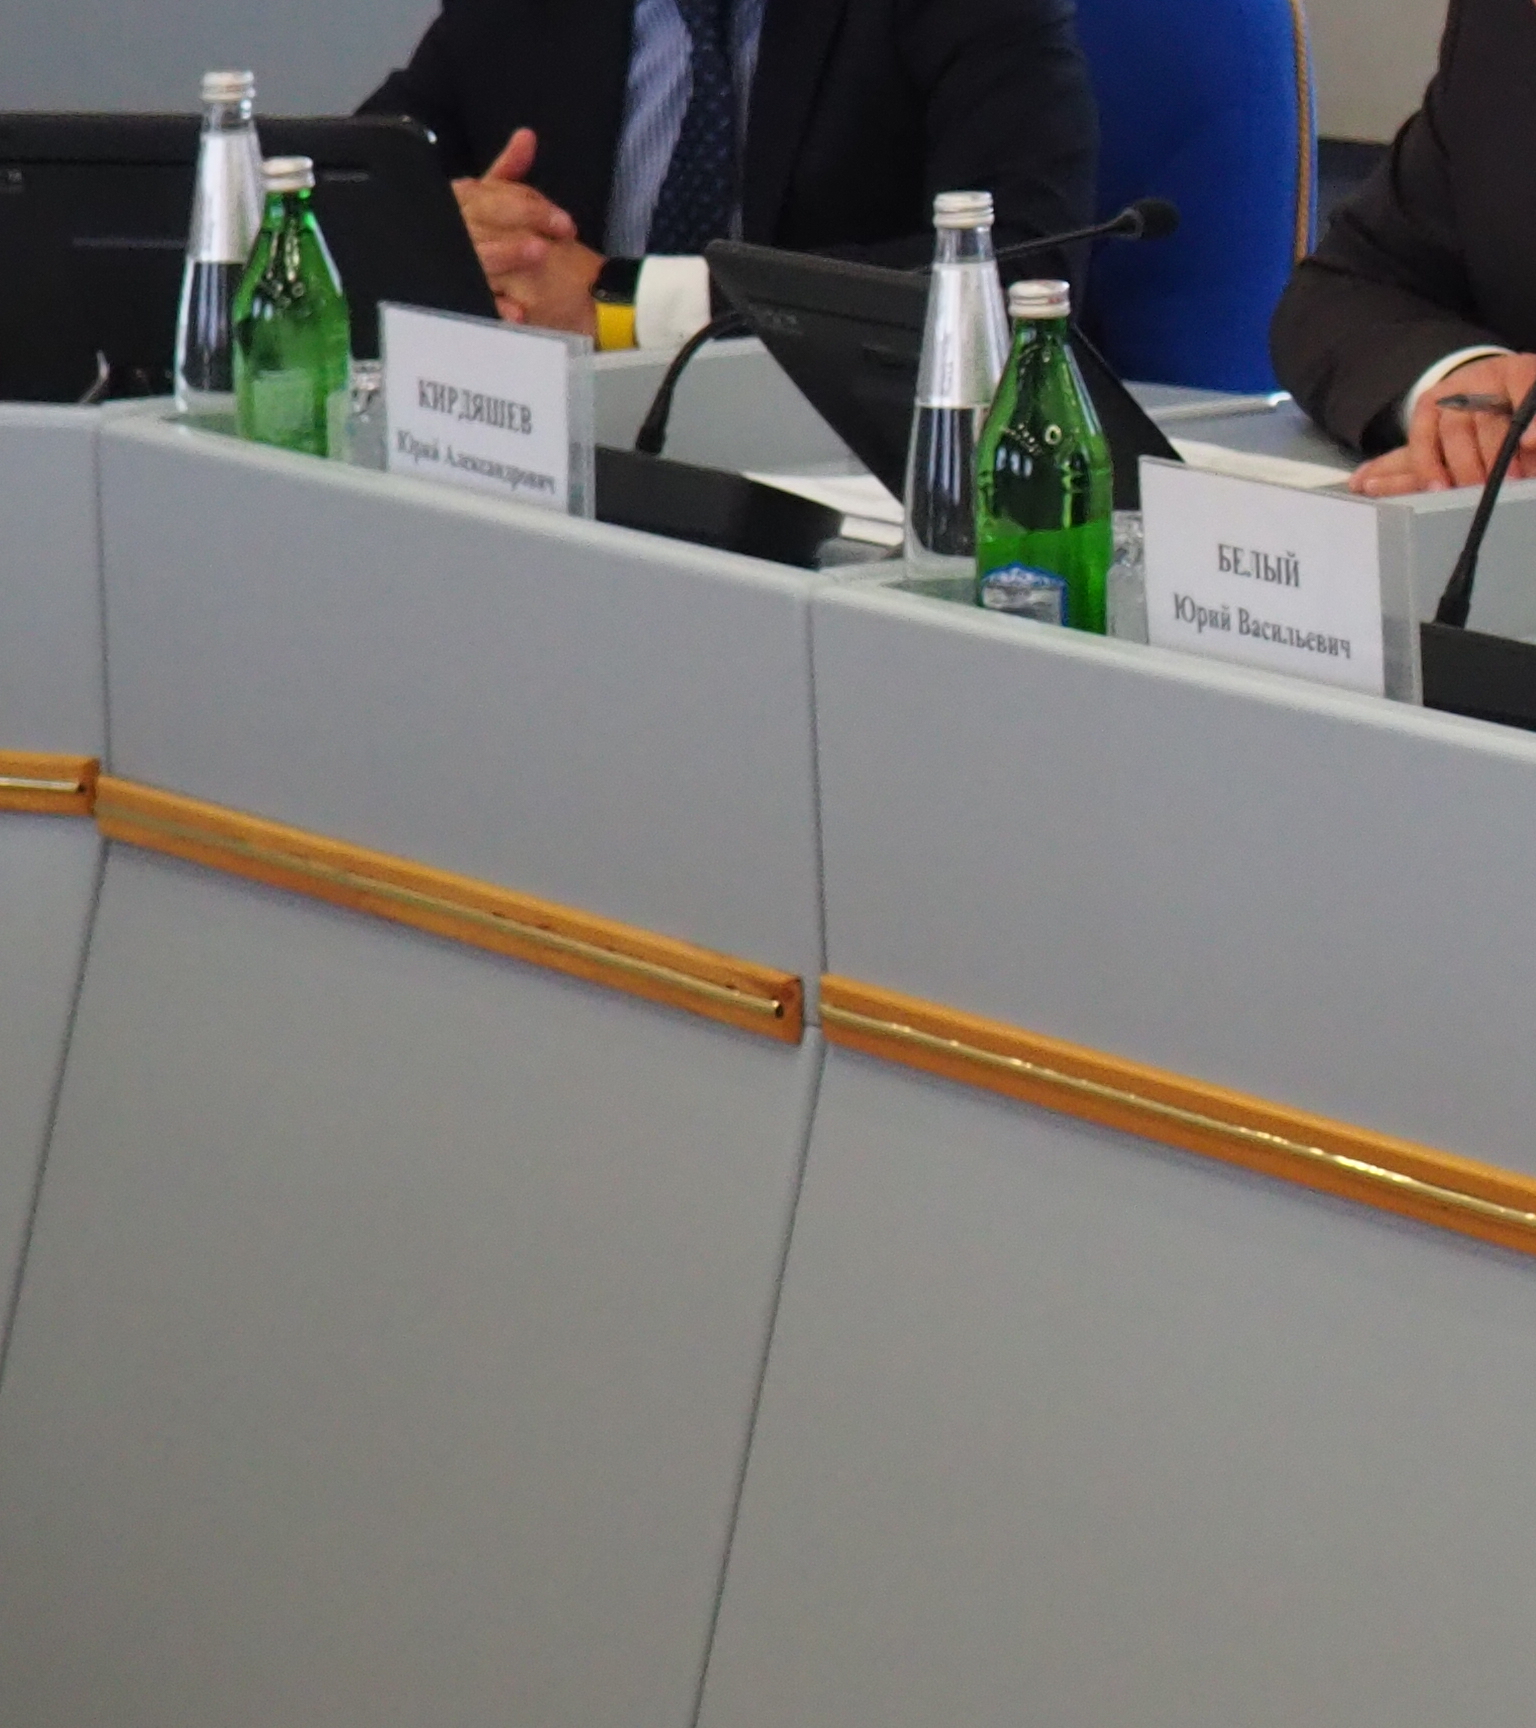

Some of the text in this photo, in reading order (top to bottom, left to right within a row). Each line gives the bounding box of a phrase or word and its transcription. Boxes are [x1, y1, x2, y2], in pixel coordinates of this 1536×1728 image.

[416, 378, 533, 435] КИРДЯШЕВ
[1217, 543, 1300, 588] БЕЛЫЙ
[1173, 593, 1352, 660] Юрий Васильевич
